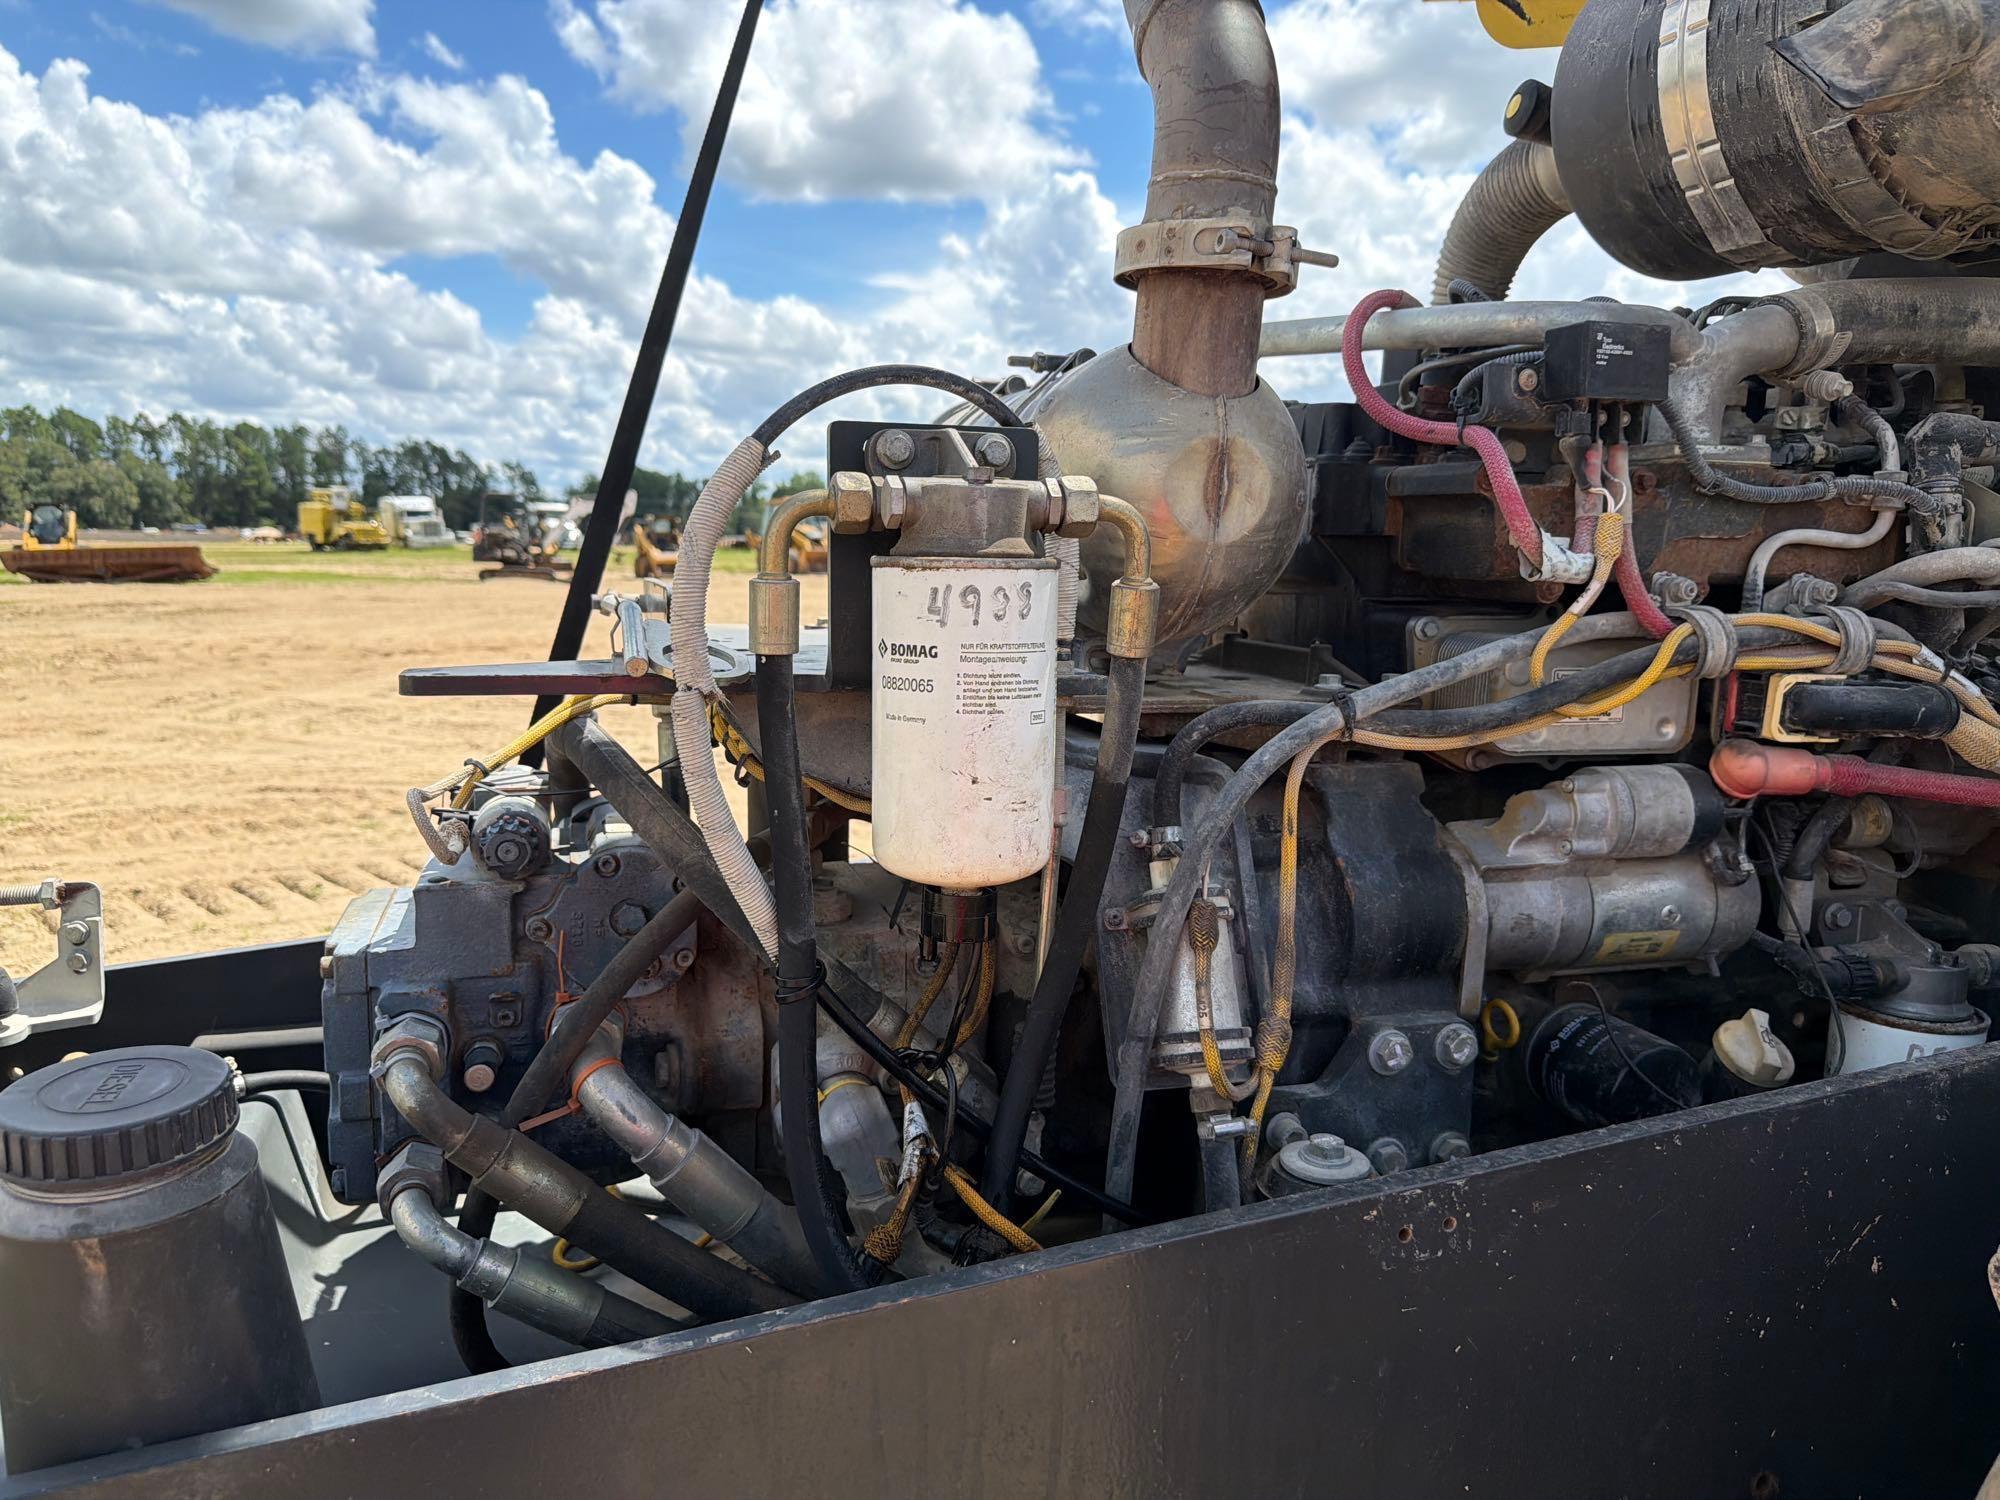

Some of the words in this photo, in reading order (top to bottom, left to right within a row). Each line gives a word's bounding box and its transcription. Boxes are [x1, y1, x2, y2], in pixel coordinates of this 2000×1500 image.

[890, 643, 938, 659] BOMAG
[975, 642, 989, 650] FÜR
[881, 675, 934, 693] 08820065
[77, 1064, 146, 1110] DIESEL
